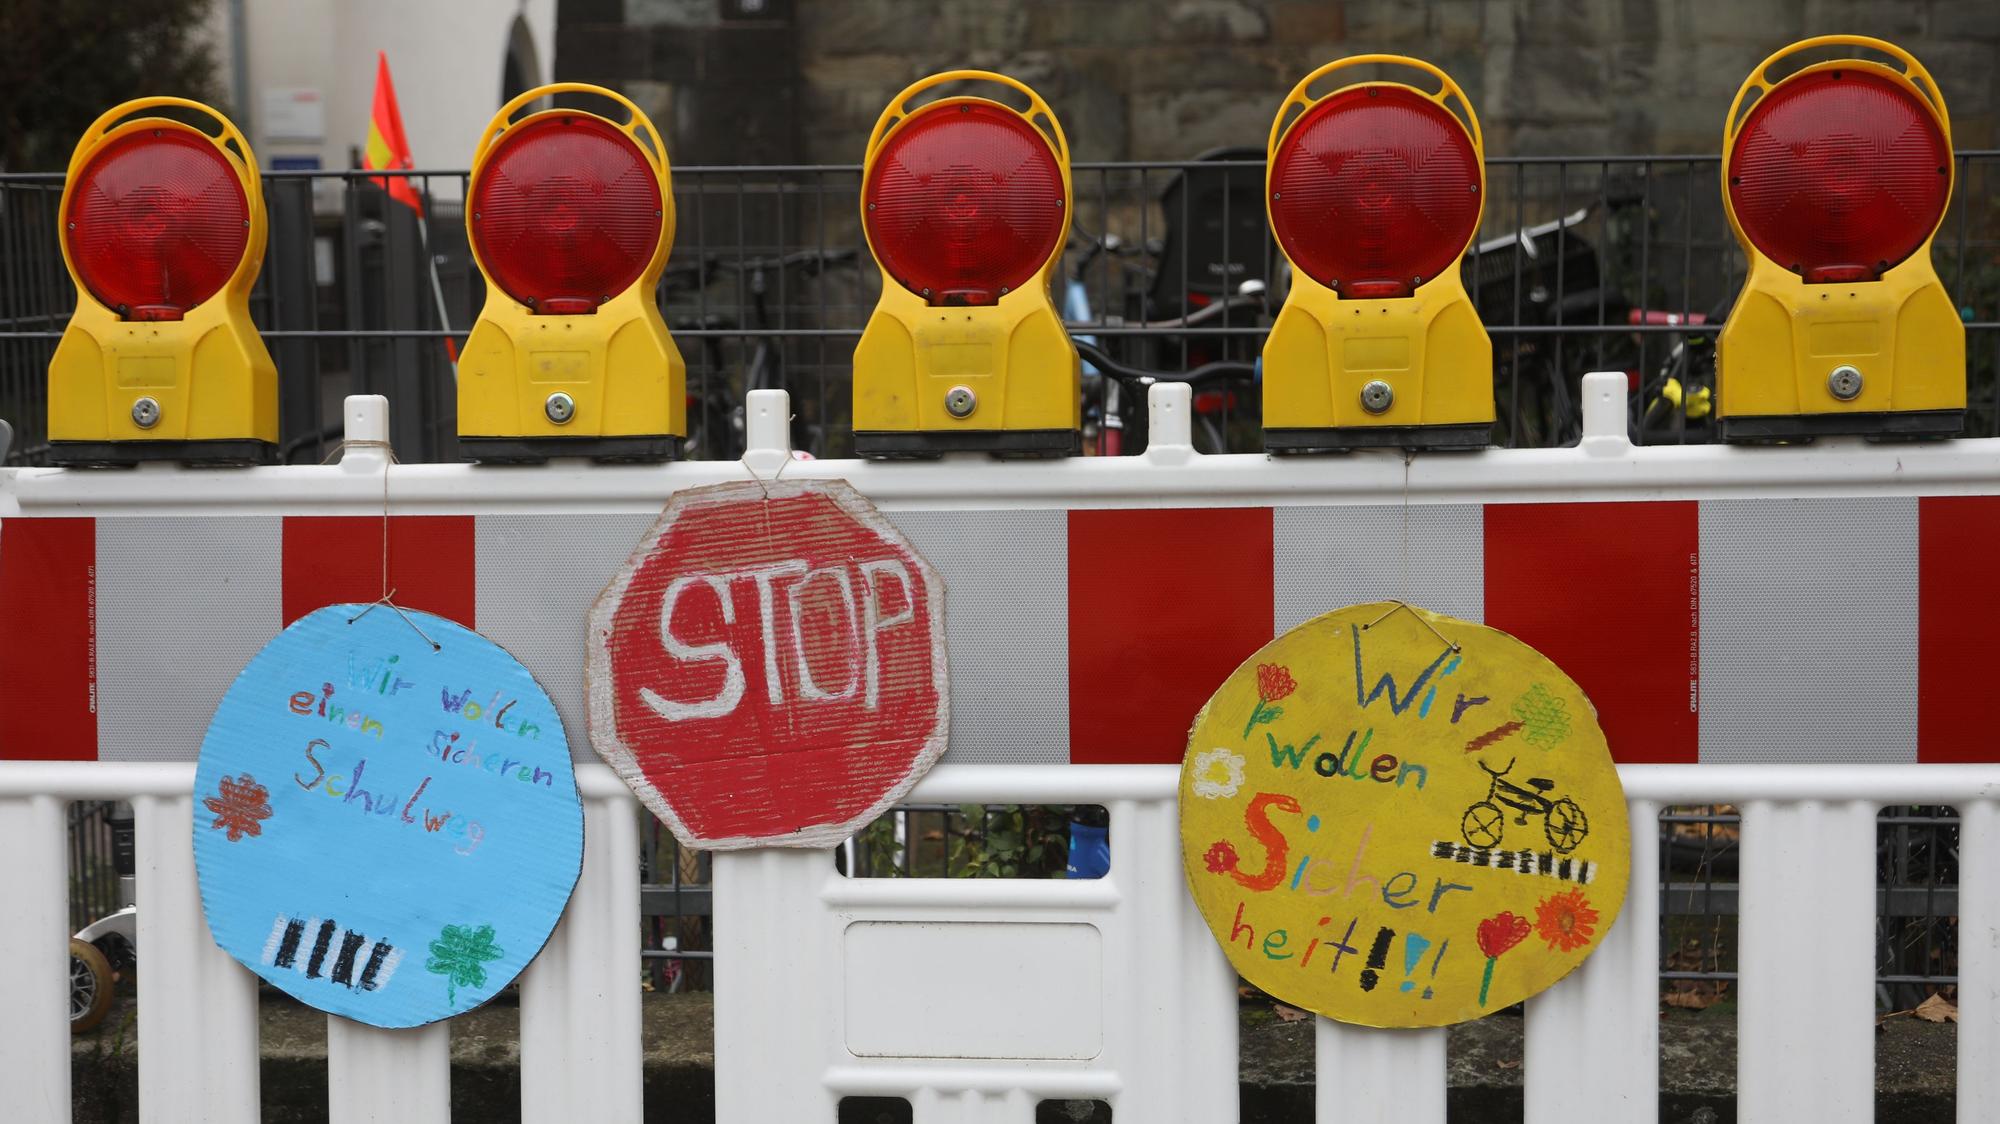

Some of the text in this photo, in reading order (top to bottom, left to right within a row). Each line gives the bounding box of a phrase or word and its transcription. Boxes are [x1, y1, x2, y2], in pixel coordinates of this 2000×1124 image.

[347, 649, 415, 696] Wir
[639, 557, 915, 722] STOP
[1352, 624, 1491, 724] Wir
[289, 682, 384, 742] einen
[294, 738, 485, 857] Schulweg
[1229, 792, 1473, 913] Sicher
